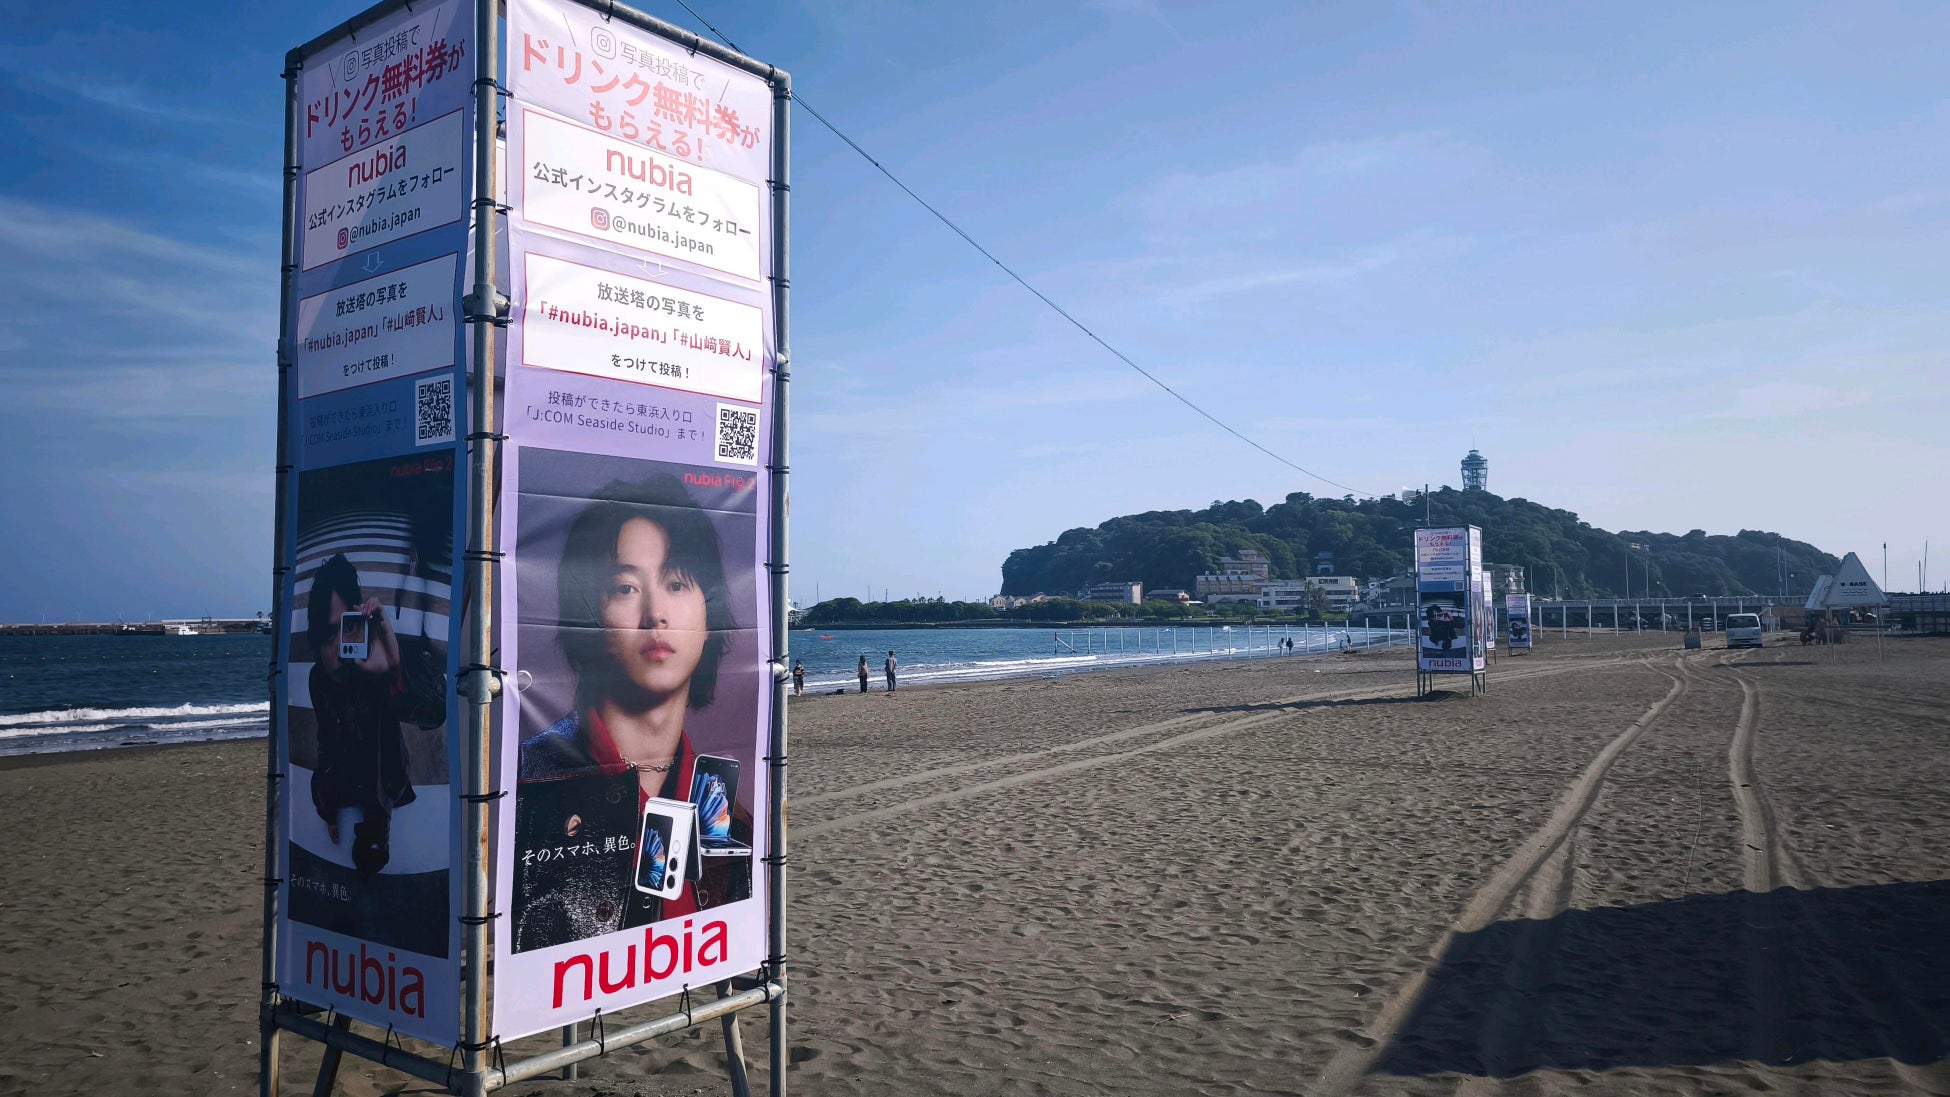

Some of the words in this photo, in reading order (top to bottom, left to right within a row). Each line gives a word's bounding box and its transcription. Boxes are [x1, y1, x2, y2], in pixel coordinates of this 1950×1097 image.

[361, 25, 421, 69] 写真投稿で
[619, 41, 706, 91] 写真投稿で
[307, 38, 465, 138] ドリンク無料券が
[523, 32, 761, 150] ドリンク無料券が
[340, 97, 417, 152] もらえる！
[588, 101, 704, 162] もらえる！
[348, 144, 406, 188] nubia
[606, 148, 693, 197] nubia
[309, 166, 455, 230] 公式インスタグラムをフォロー
[532, 161, 752, 237] 公式インスタグラムをフォロー
[350, 206, 421, 243] @nubia.japan
[612, 215, 715, 256] @nubia.japan
[335, 281, 408, 317] 放送塔の写真を
[597, 281, 706, 322] 放送塔の写真を
[342, 353, 395, 377] をつけて投稿！
[611, 354, 690, 379] をつけて投稿！
[526, 405, 574, 425] 「J:COM
[577, 414, 625, 432] Seaside
[548, 390, 693, 424] 投稿ができたら東浜入り口
[684, 471, 722, 488] nubia
[724, 473, 746, 492] Fl
[1428, 659, 1462, 668] nubia
[521, 835, 636, 866] そのスマホ、異色。
[306, 940, 425, 1019] nubia
[552, 919, 728, 1010] nubia
